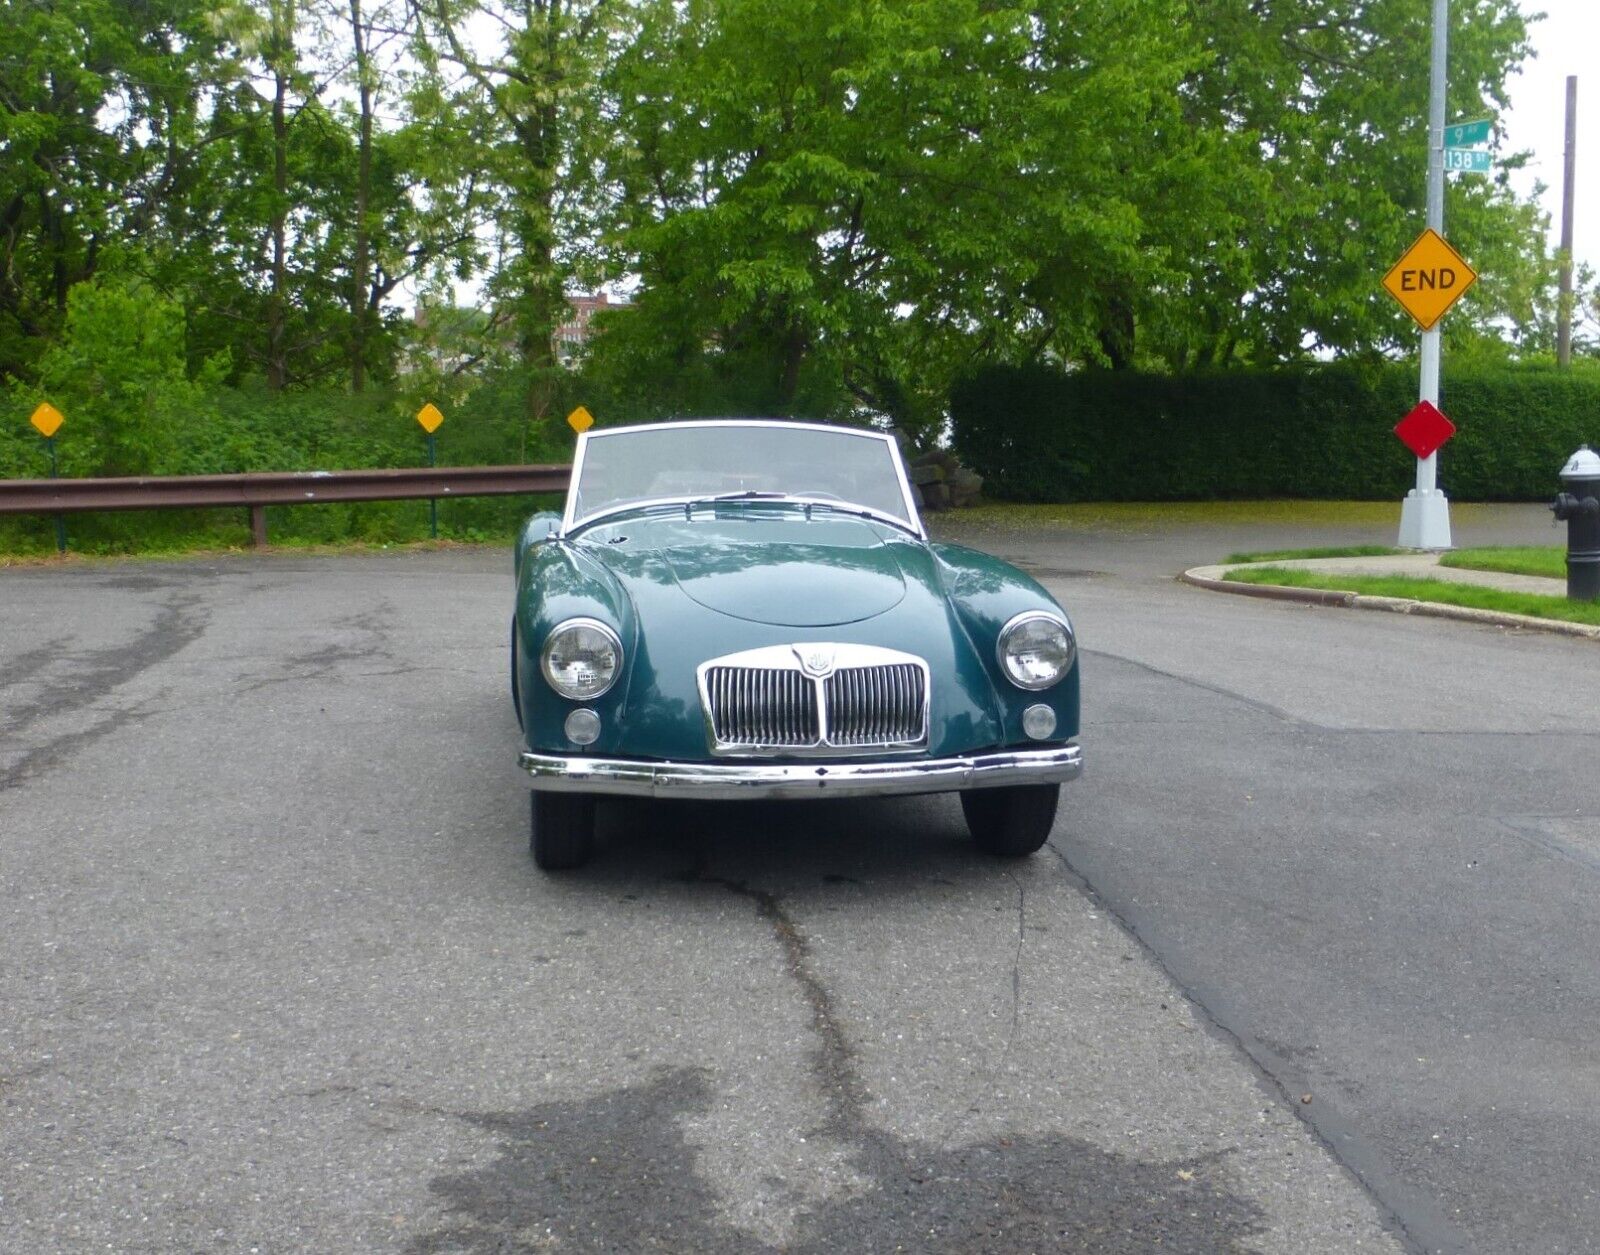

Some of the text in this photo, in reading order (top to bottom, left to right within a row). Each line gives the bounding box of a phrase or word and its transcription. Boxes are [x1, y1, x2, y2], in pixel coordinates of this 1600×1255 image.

[1455, 127, 1464, 144] 9
[1448, 151, 1472, 169] 138
[1401, 268, 1455, 291] END
